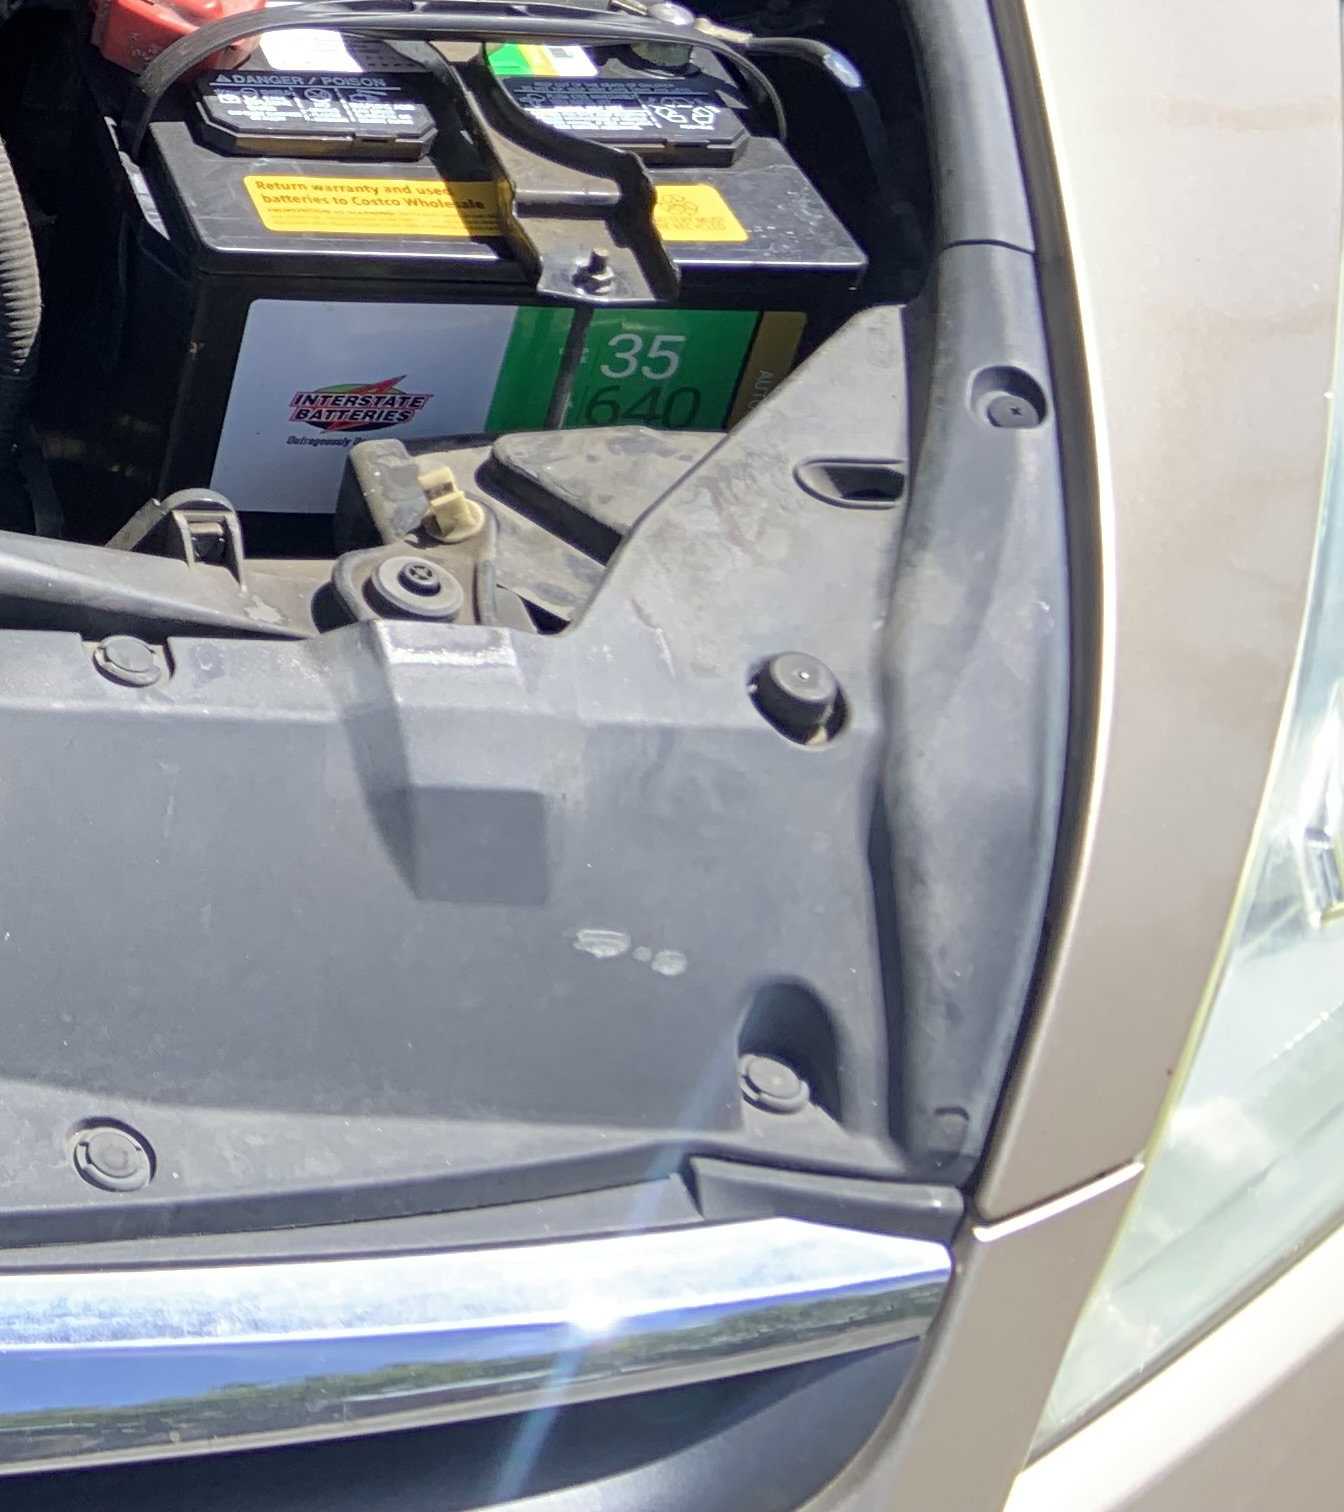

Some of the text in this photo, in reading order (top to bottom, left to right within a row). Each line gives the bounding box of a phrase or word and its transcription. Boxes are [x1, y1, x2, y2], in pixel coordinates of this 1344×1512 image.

[231, 74, 305, 86] DANGER
[322, 76, 386, 88] POISON
[255, 180, 454, 197] Return warranty and used
[262, 194, 485, 210] batteries to Costco Wholesale
[600, 333, 686, 380] 35
[292, 393, 425, 409] INTERSTATE
[583, 384, 701, 428] 640
[294, 408, 412, 422] BATTERIES
[286, 435, 352, 448] Outrageously
